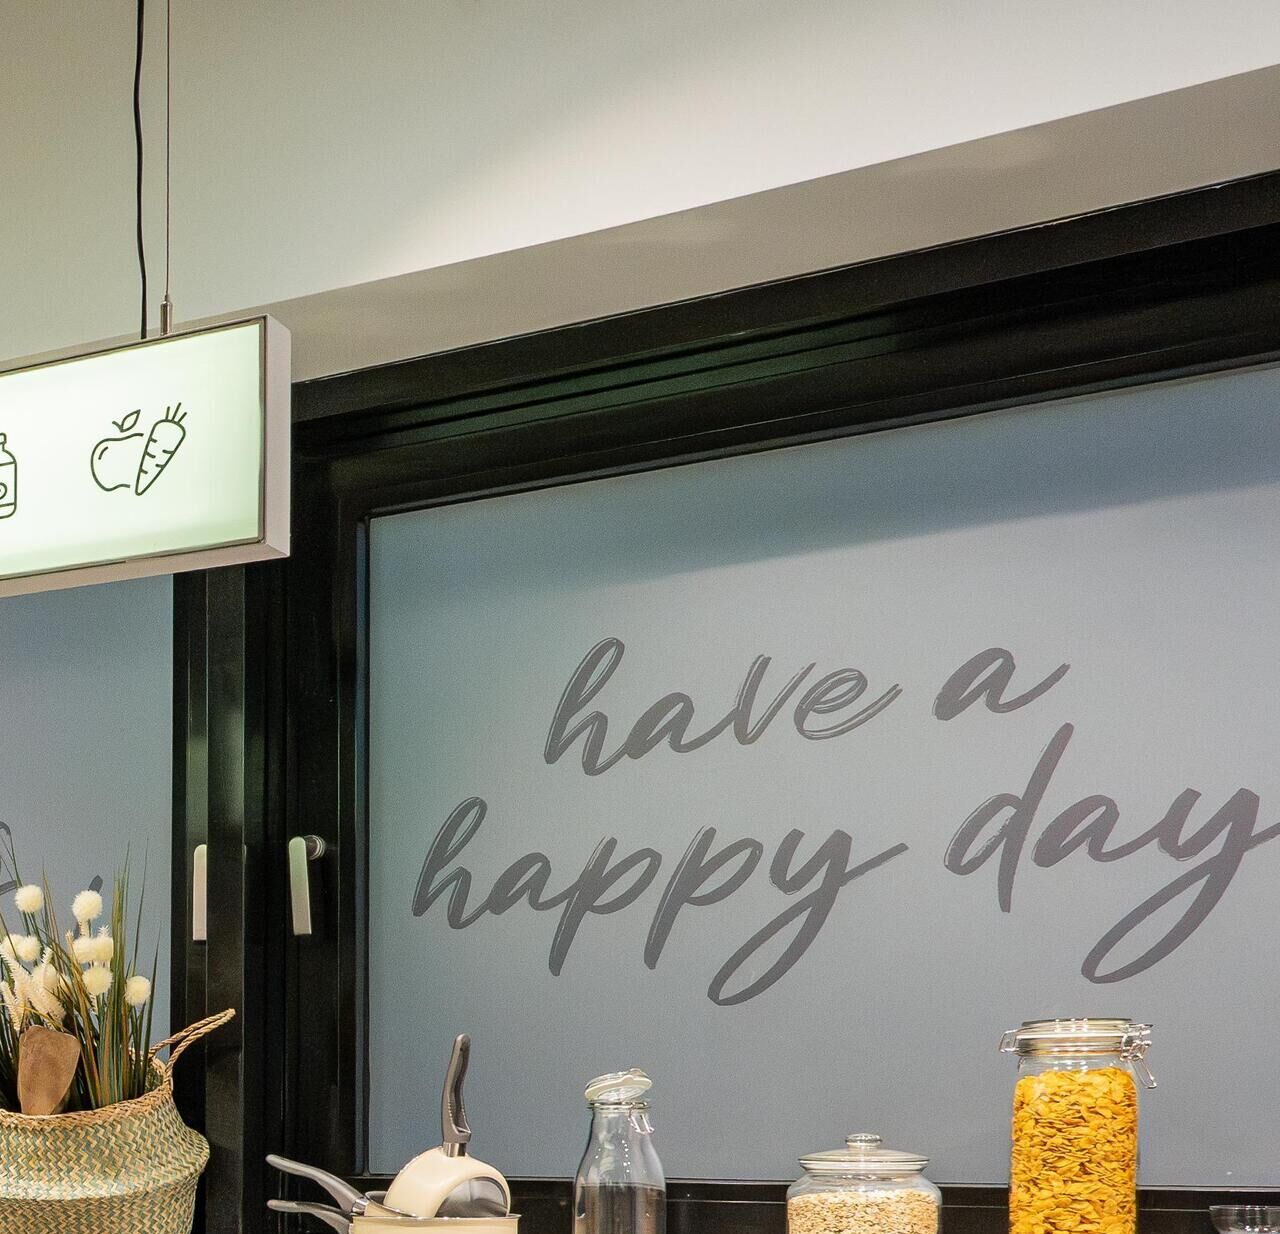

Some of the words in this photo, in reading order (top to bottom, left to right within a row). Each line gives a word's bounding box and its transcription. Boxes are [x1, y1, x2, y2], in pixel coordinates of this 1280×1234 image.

[543, 637, 903, 777] have
[932, 647, 1071, 722] a
[413, 797, 909, 1007] happy
[943, 722, 1280, 985] day
